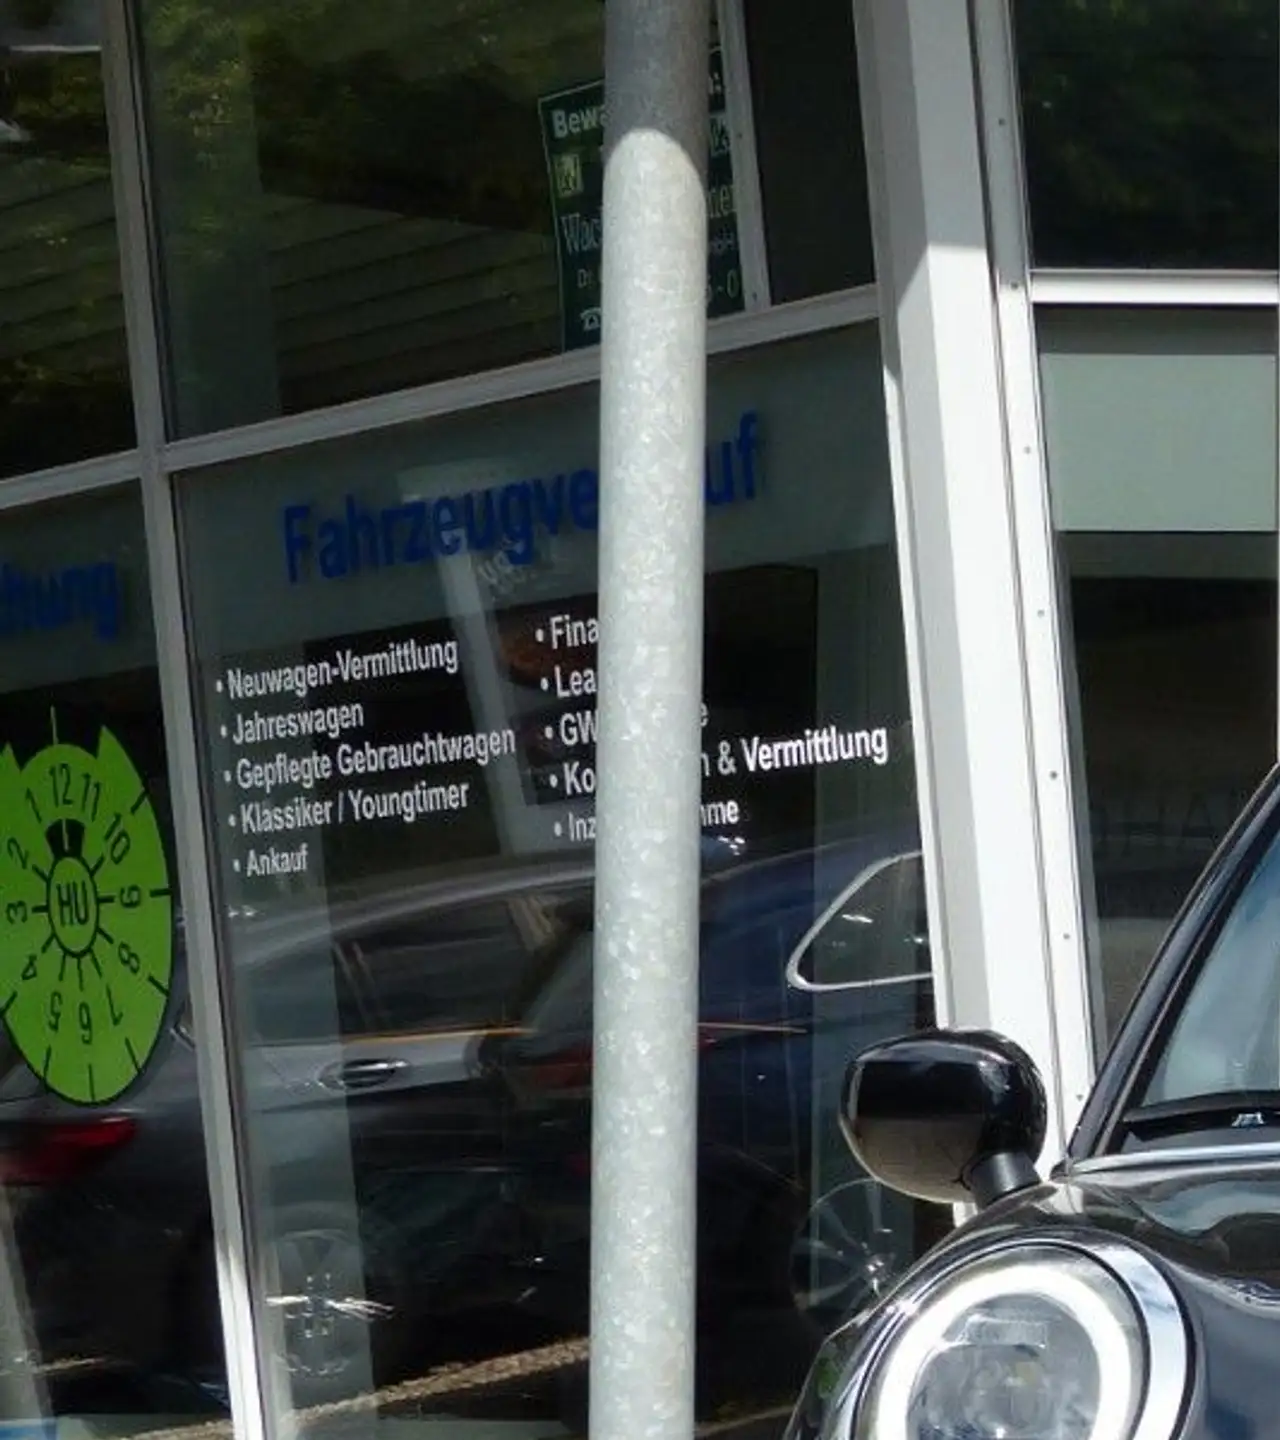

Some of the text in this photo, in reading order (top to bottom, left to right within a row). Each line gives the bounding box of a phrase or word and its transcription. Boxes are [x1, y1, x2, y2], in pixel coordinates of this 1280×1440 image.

[283, 411, 759, 583] Fahrzeugveuf
[227, 638, 459, 700] Neuwagen-Vermittlung
[232, 701, 364, 746] Jahreswagen
[236, 752, 333, 794] Gepflegte
[337, 728, 516, 776] Gebrauchtwagen
[741, 726, 888, 773] Vermittlung
[240, 798, 333, 834] Klassiker
[347, 780, 470, 823] Youngtimer
[246, 843, 309, 878] Ankauf
[56, 880, 90, 928] HU
